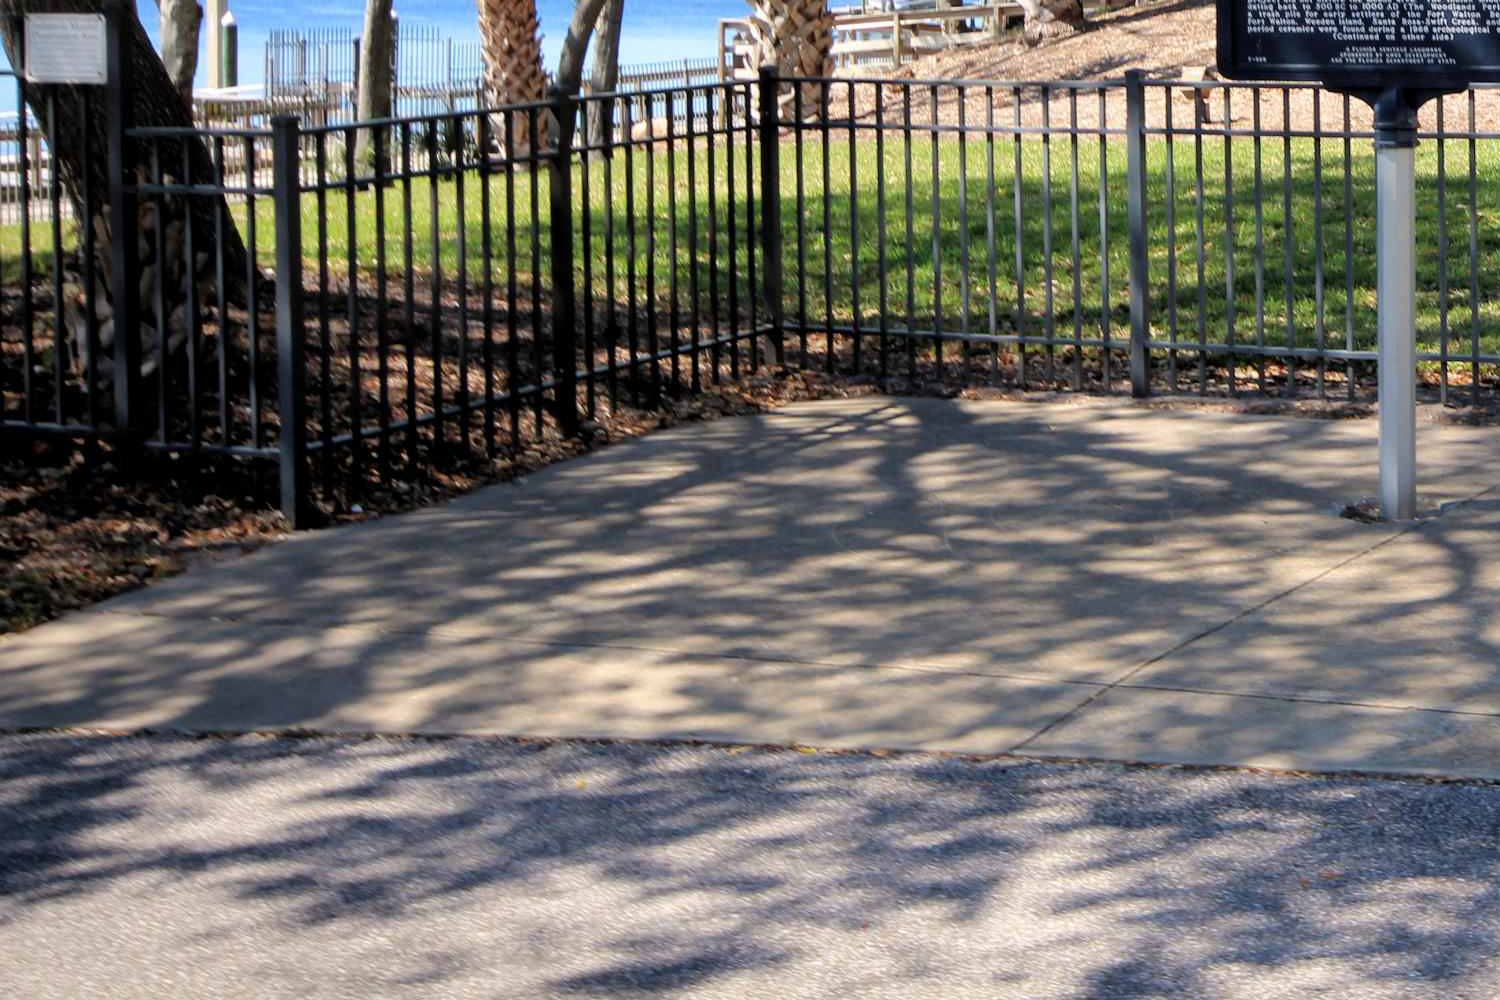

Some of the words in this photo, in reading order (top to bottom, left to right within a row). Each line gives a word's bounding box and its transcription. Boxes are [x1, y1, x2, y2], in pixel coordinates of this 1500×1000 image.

[1324, 11, 1346, 19] early
[1247, 26, 1274, 34] period
[1368, 26, 1395, 34] during
[1432, 26, 1490, 35] archeological
[1333, 33, 1379, 42] (Continued
